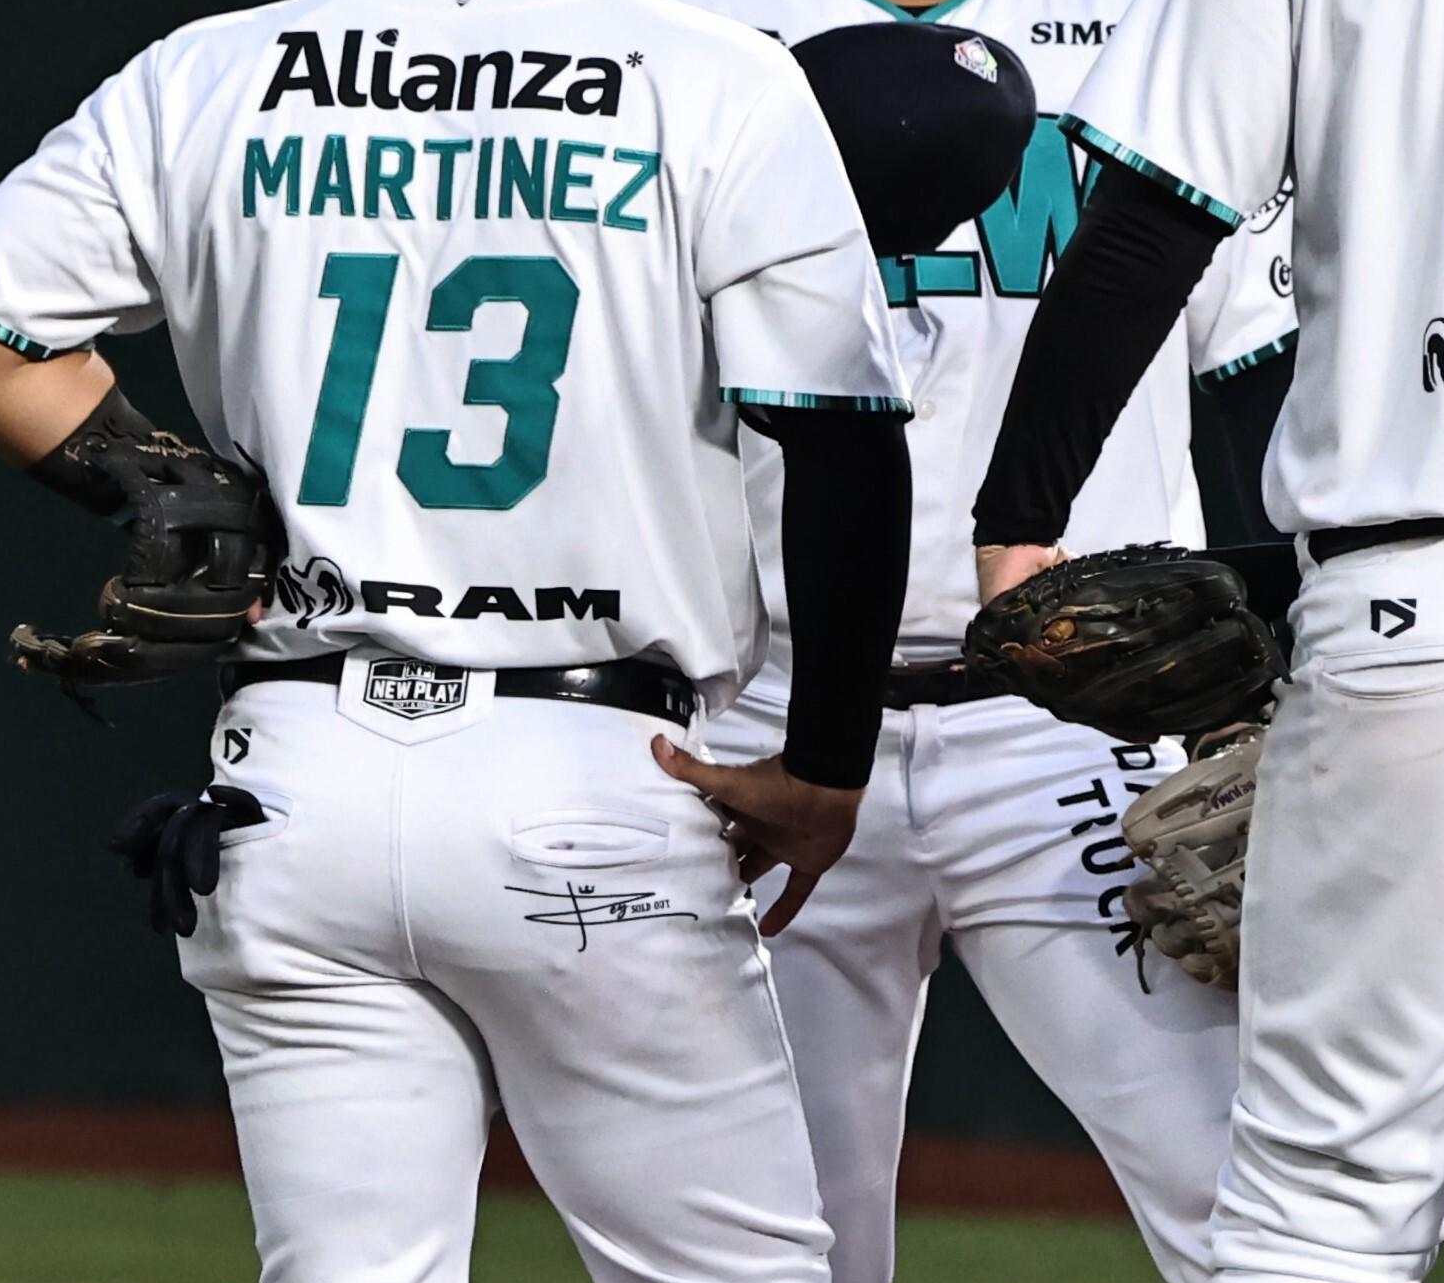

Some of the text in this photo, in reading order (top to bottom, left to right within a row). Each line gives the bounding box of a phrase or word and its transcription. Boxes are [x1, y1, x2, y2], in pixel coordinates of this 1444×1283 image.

[258, 29, 623, 118] Alianza
[242, 134, 661, 233] MARTINEZ
[297, 251, 580, 510] 13
[359, 579, 622, 623] RAM
[372, 679, 459, 703] NEW PLAY
[630, 902, 652, 914] SOLD
